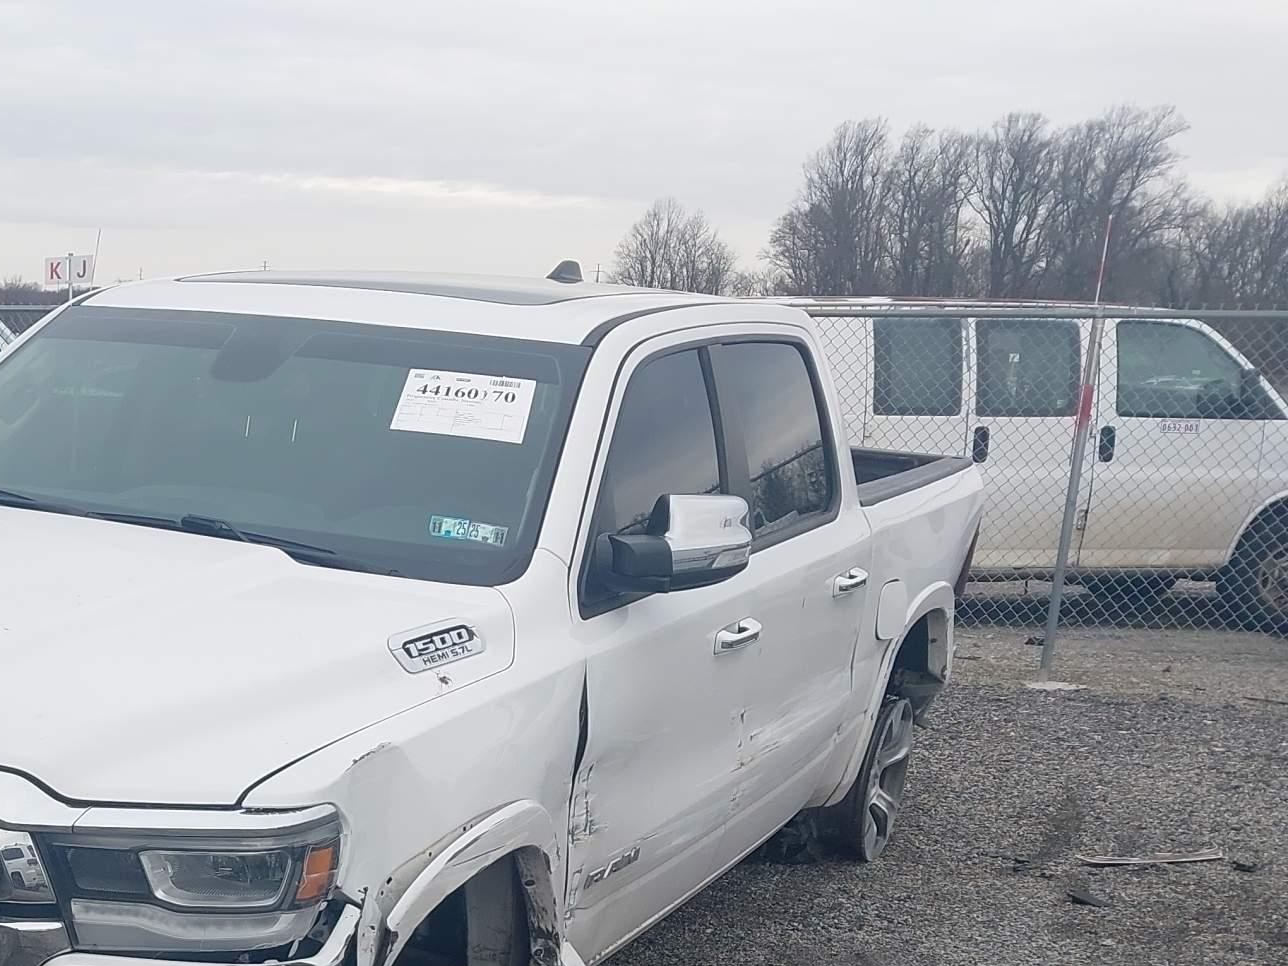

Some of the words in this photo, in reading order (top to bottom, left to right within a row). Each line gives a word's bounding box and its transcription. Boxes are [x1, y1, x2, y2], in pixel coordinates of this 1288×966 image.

[50, 261, 62, 280] K
[76, 259, 86, 279] J
[456, 520, 467, 536] 25
[469, 523, 481, 538] 25
[404, 627, 471, 658] 1500
[422, 651, 450, 666] HEMI
[451, 645, 473, 658] 5.7L
